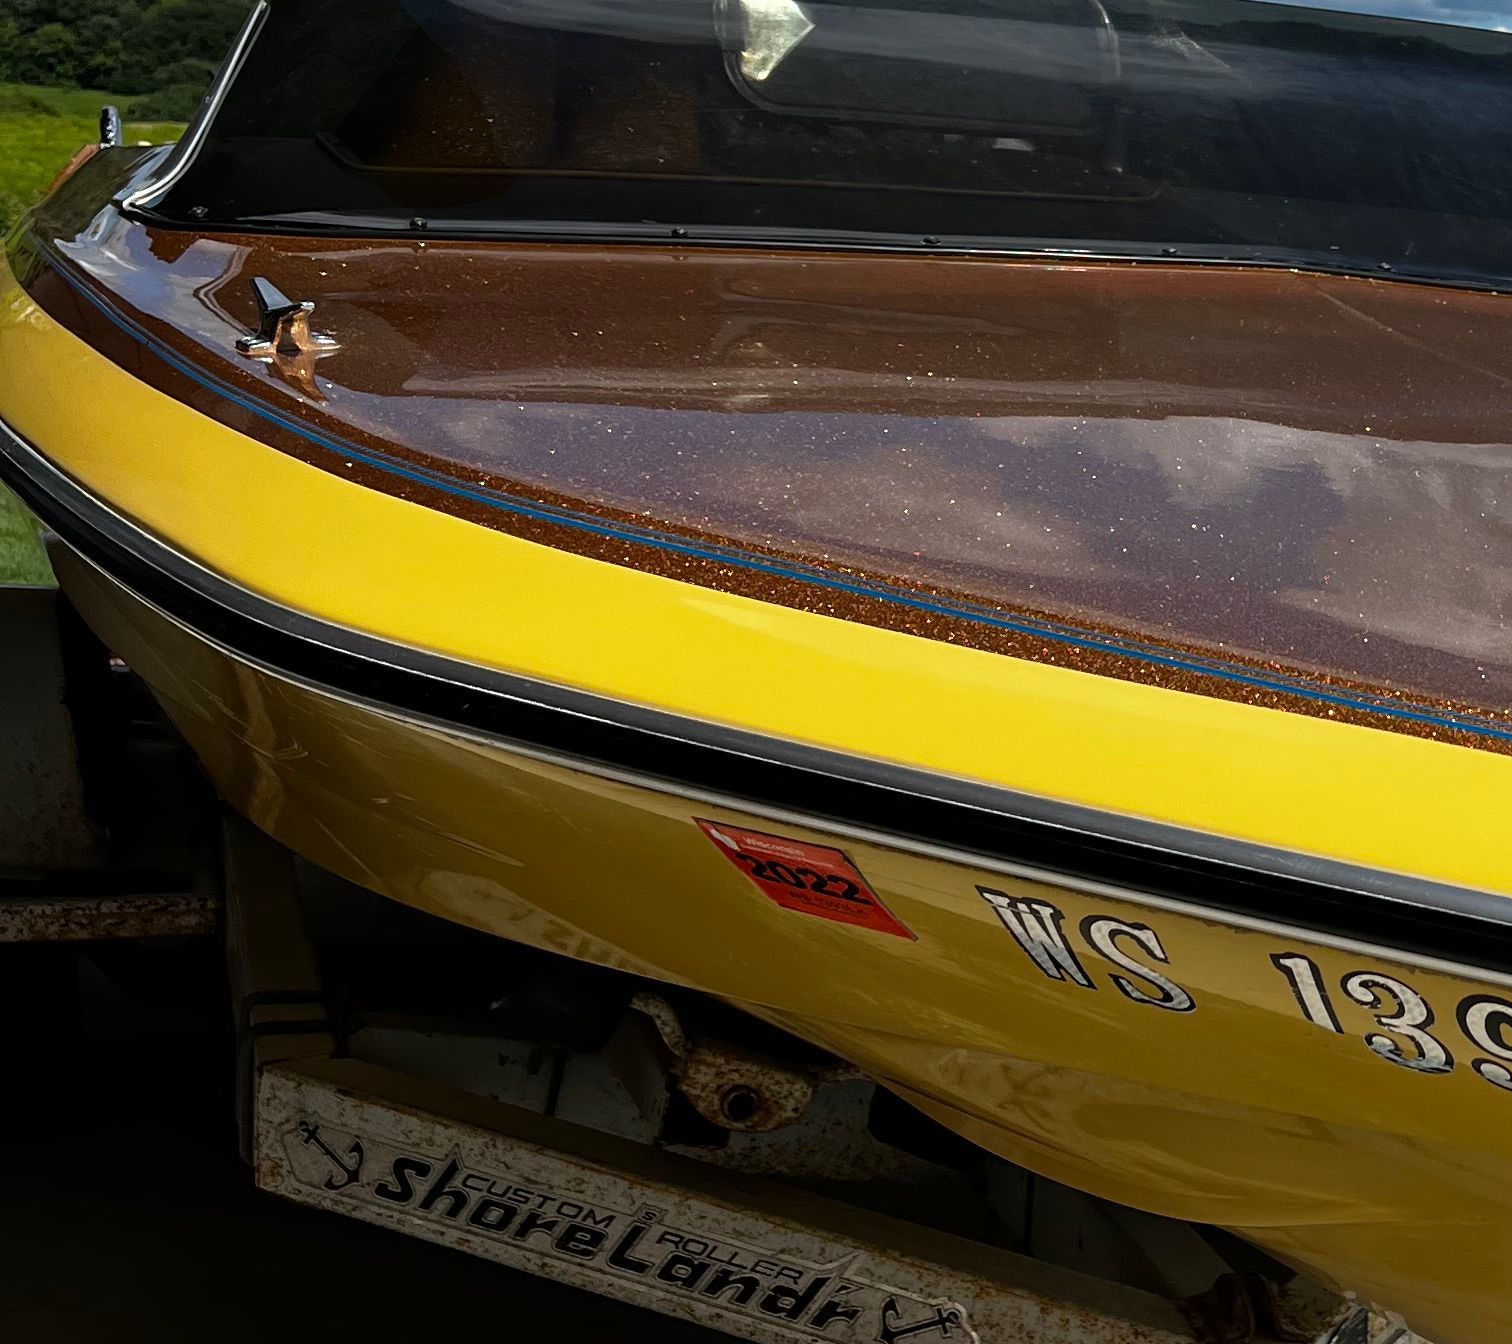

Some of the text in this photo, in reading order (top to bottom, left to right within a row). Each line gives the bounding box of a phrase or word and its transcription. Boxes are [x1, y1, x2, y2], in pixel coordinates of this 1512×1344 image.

[734, 851, 874, 907] 2022
[975, 885, 1197, 1013] WS
[461, 1173, 804, 1286] CUSTOM ROLLER
